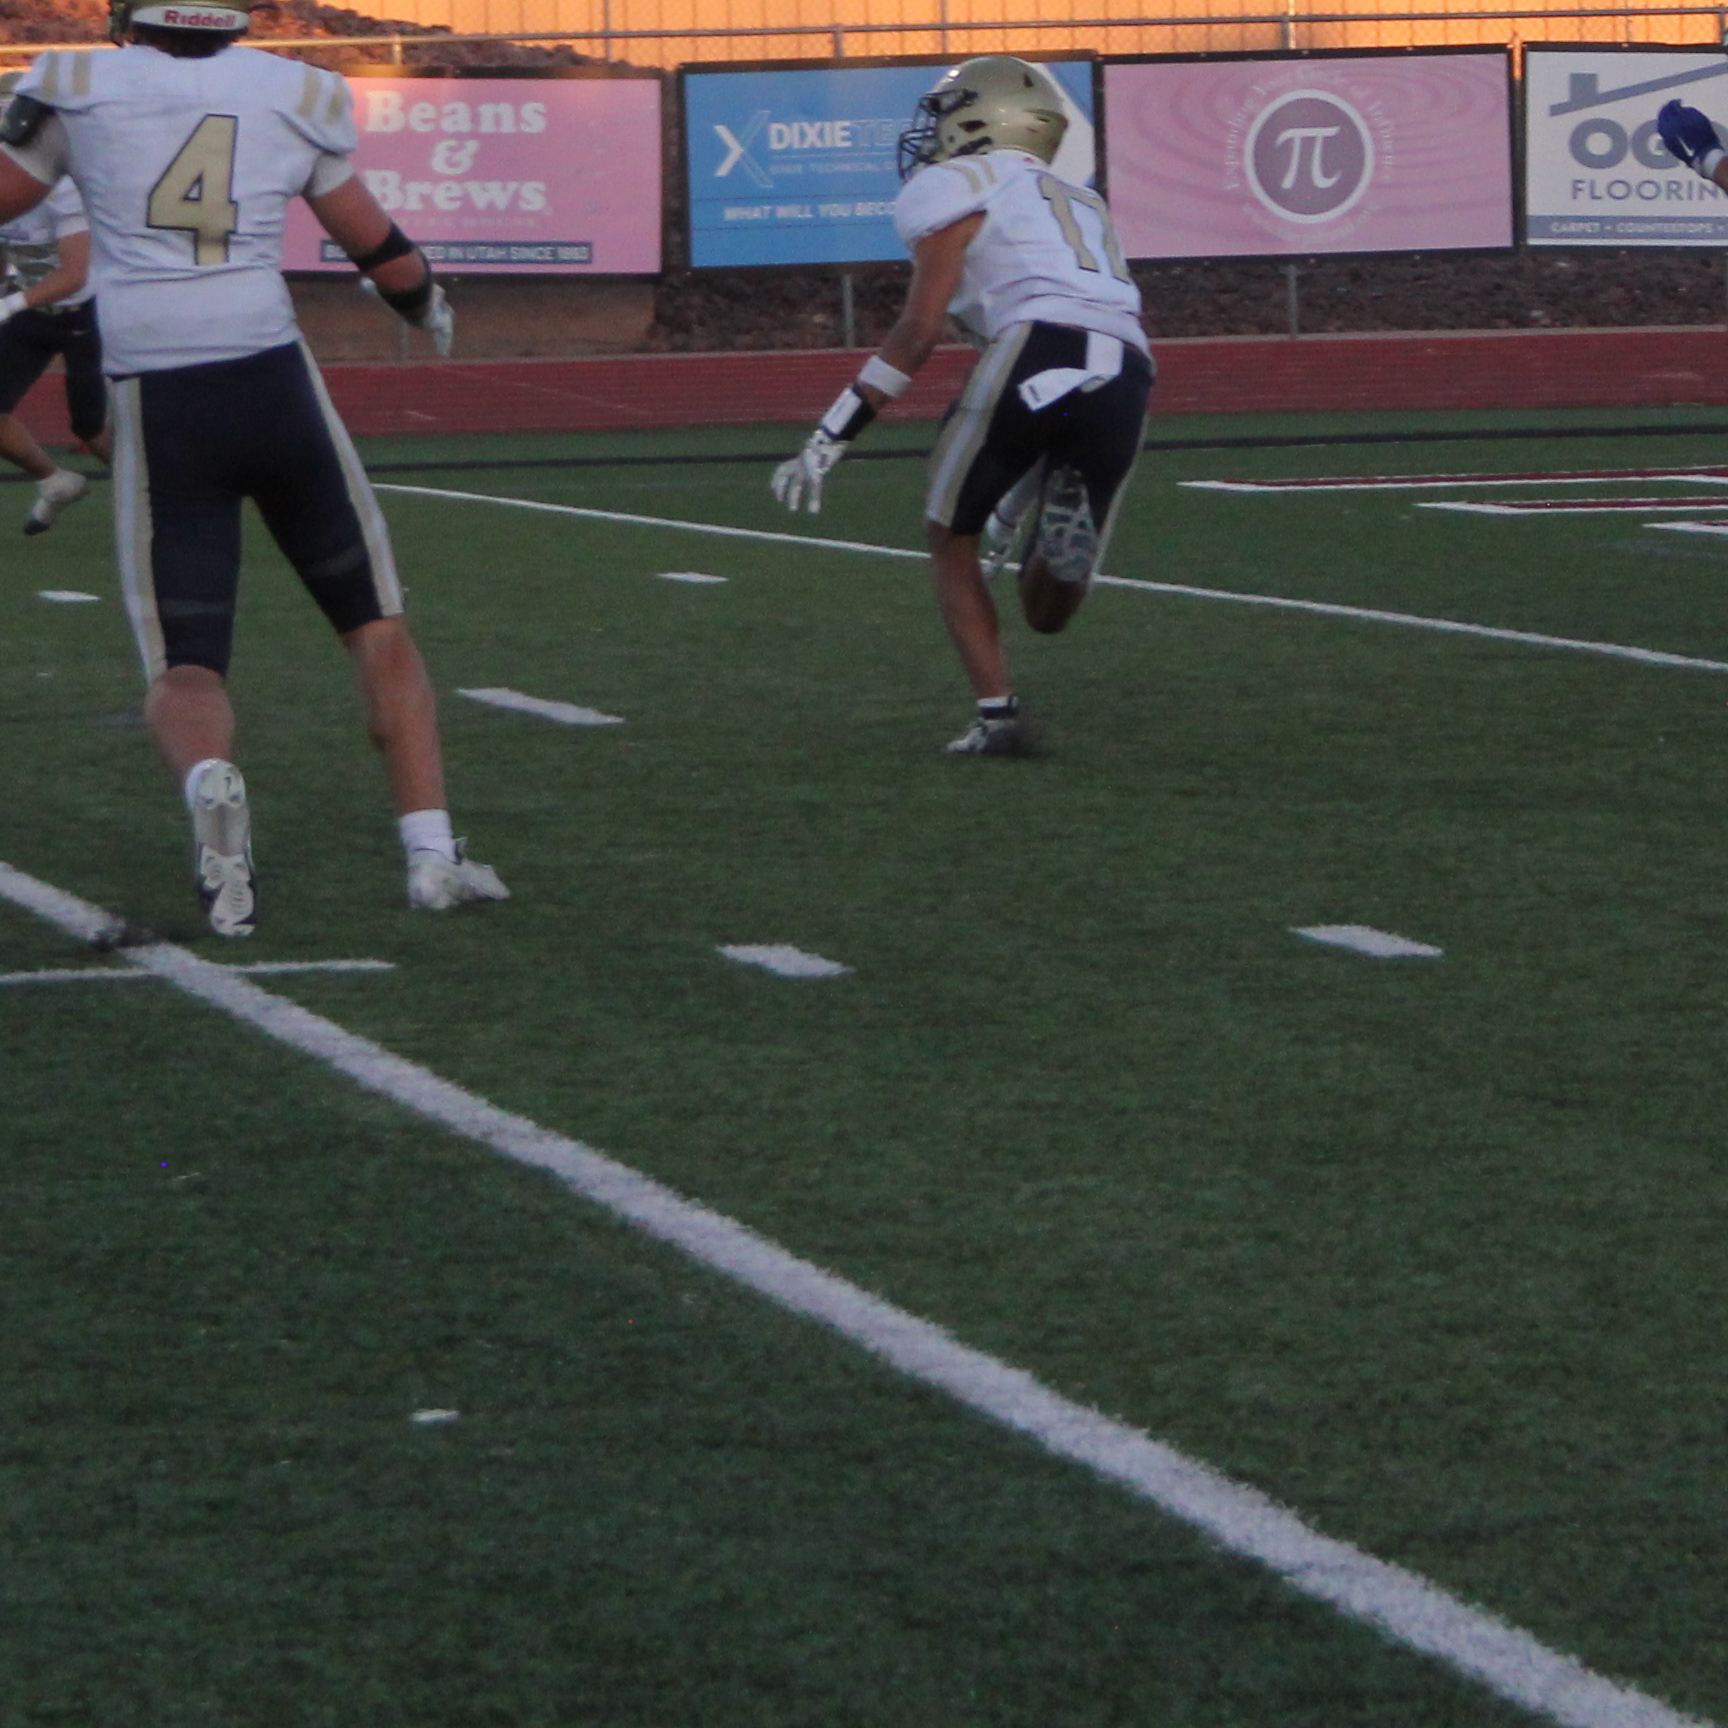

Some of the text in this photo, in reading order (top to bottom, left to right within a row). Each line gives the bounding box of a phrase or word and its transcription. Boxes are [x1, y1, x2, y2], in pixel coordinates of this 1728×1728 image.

[165, 9, 235, 28] Riddell
[365, 89, 547, 133] Beans
[430, 139, 480, 175] &
[146, 113, 238, 266] 4
[363, 169, 547, 211] Brews
